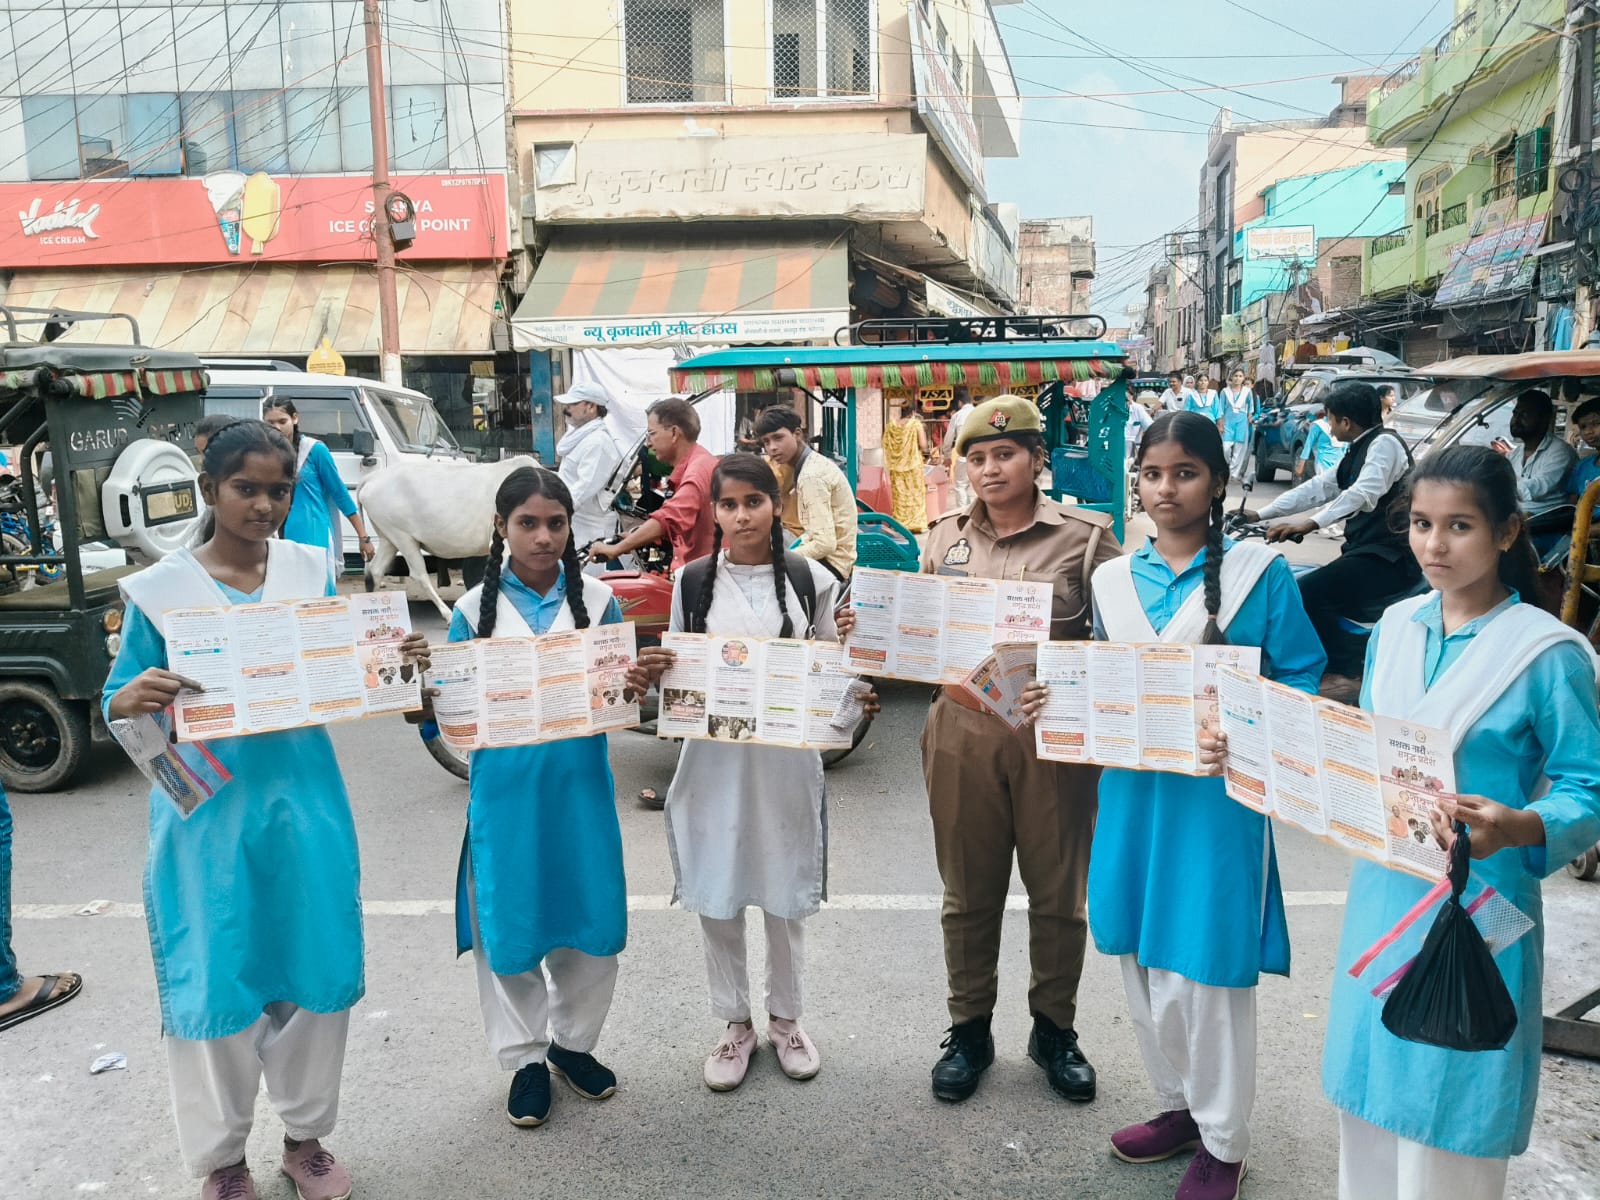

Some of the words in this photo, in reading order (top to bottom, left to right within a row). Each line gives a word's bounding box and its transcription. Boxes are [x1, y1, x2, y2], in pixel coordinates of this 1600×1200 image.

[329, 221, 355, 233] ICE
[421, 219, 471, 231] POINT
[55, 236, 86, 245] CREAM
[583, 326, 606, 342] न्यू
[607, 320, 661, 342] बृजवासी
[666, 320, 699, 337] स्वीट
[702, 322, 738, 336] हाउस
[70, 428, 128, 451] GARUD
